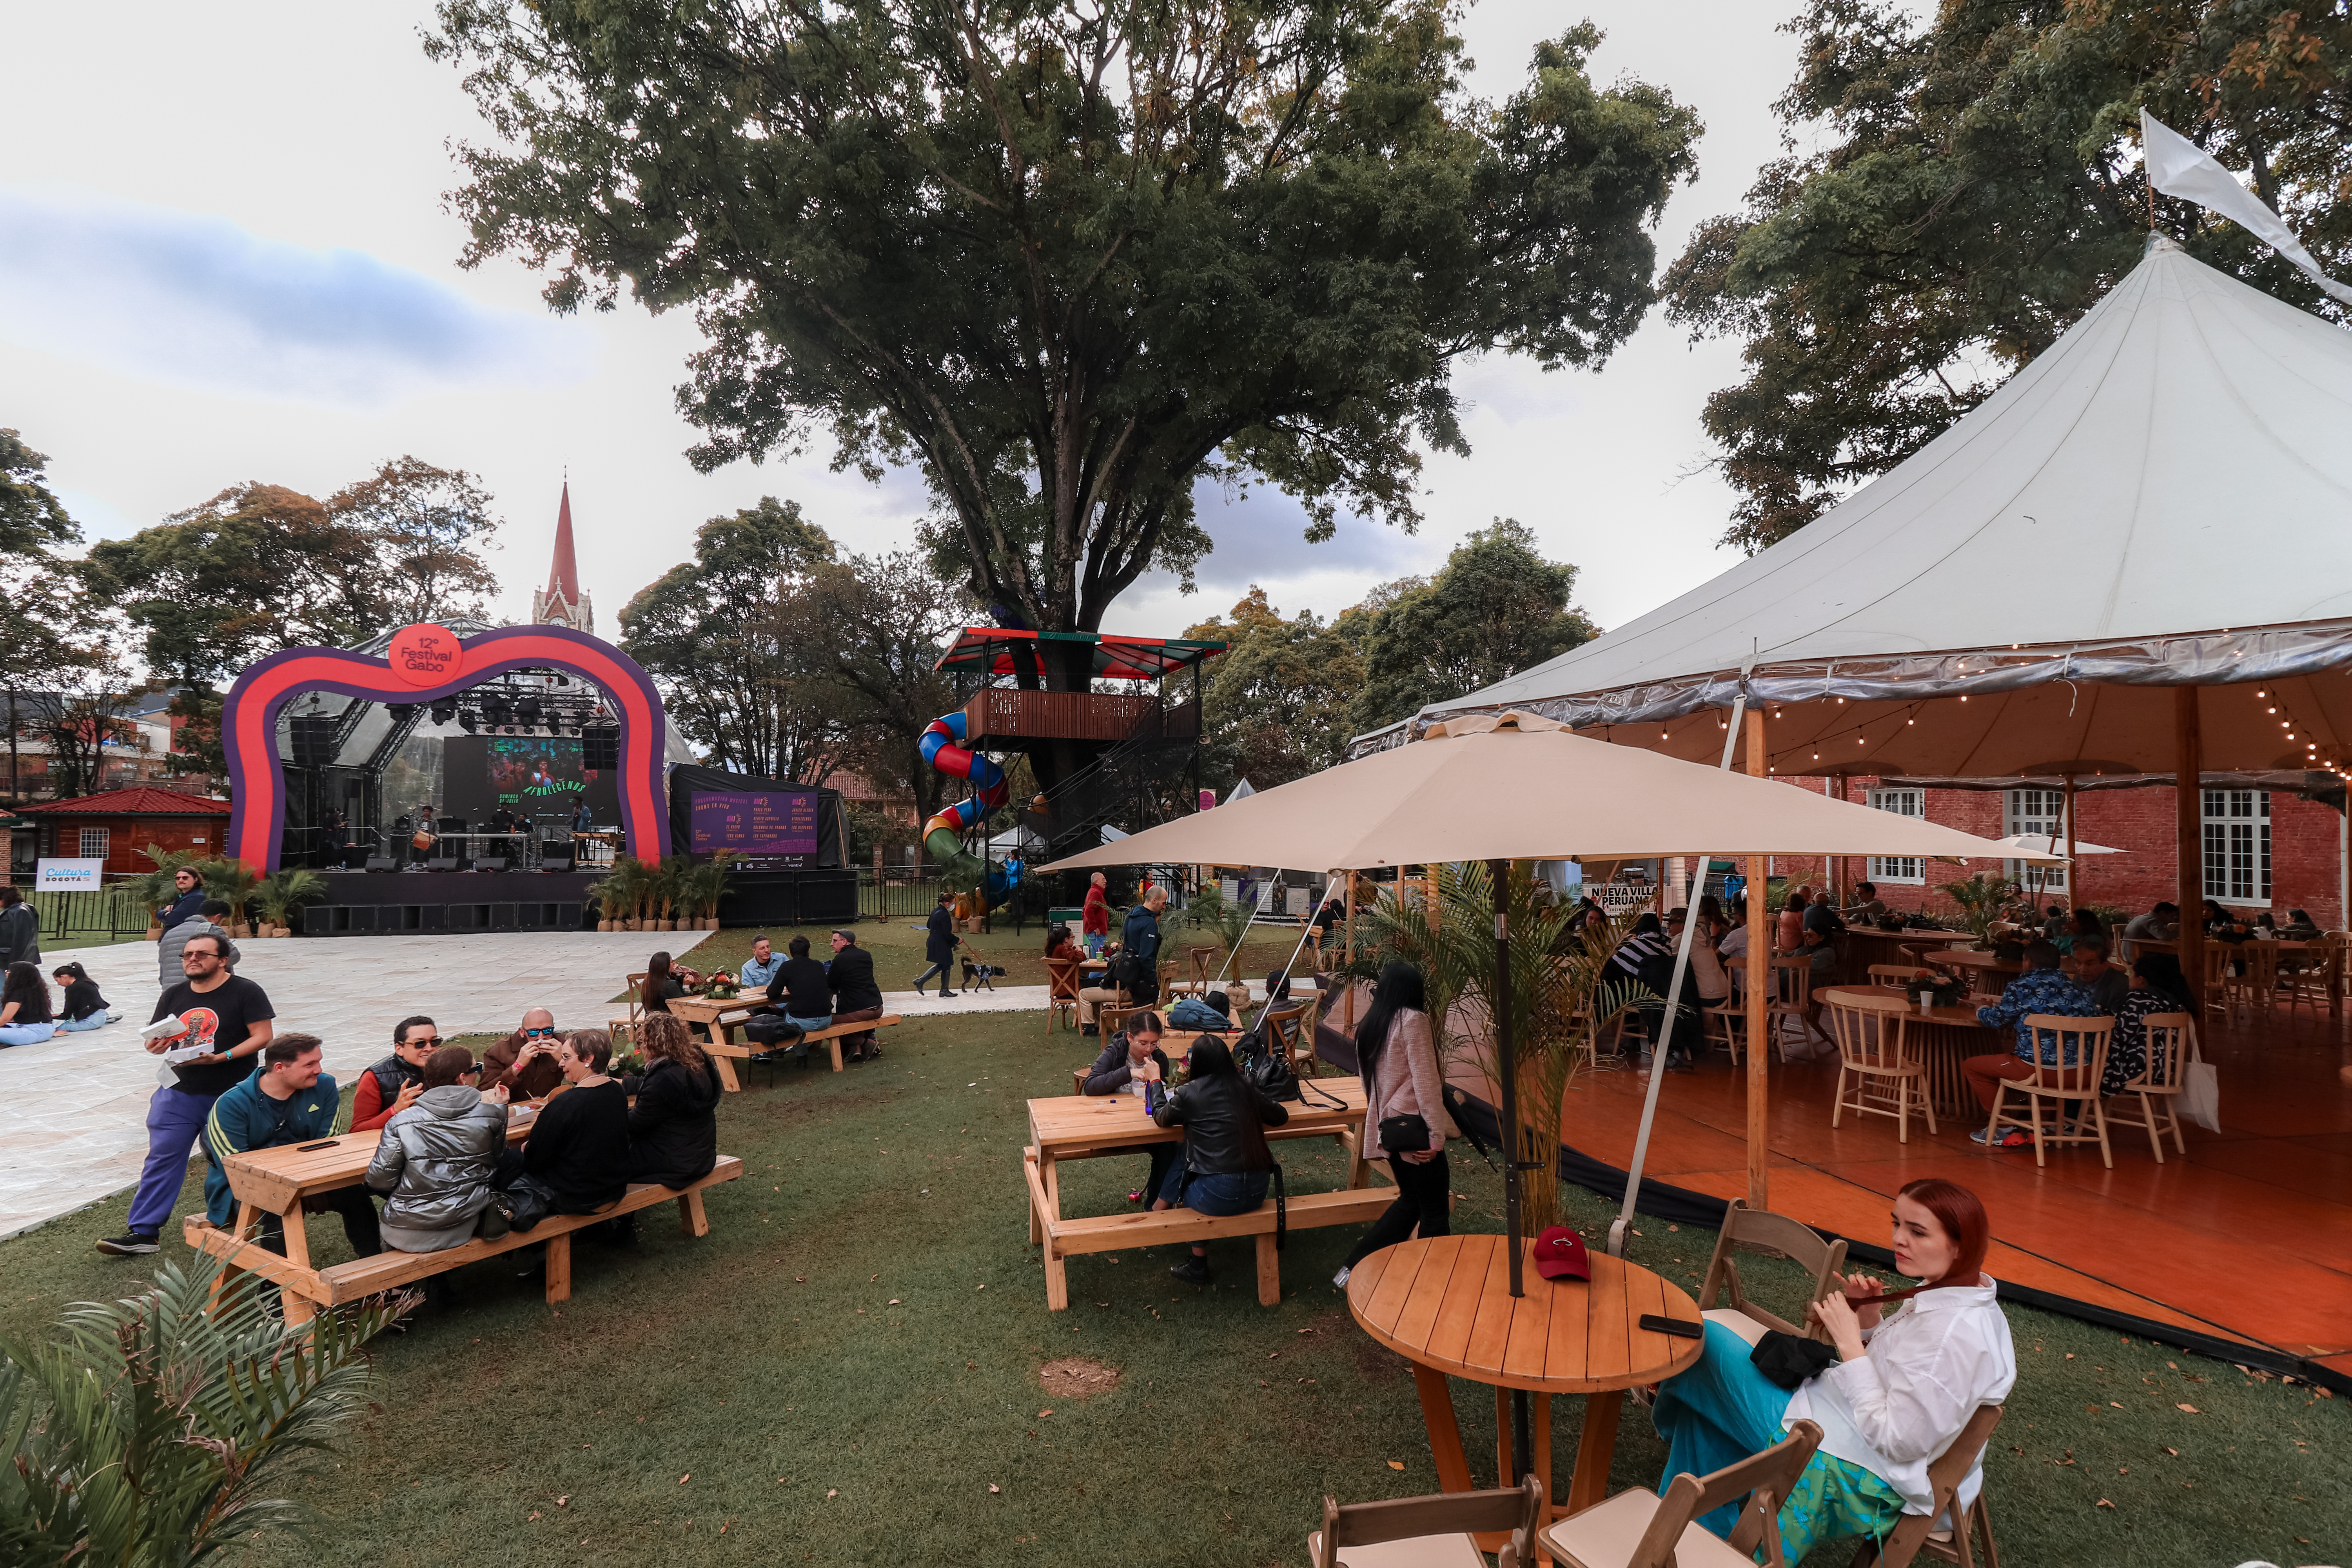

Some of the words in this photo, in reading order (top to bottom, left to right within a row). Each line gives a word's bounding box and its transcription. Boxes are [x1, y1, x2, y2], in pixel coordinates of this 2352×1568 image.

[401, 647, 452, 662] Festival
[406, 659, 444, 672] Gabo
[523, 780, 586, 796] AFROLEGENDS
[46, 868, 92, 877] Cultura
[1592, 887, 1628, 896] NUEVA
[1630, 887, 1657, 896] VILLA
